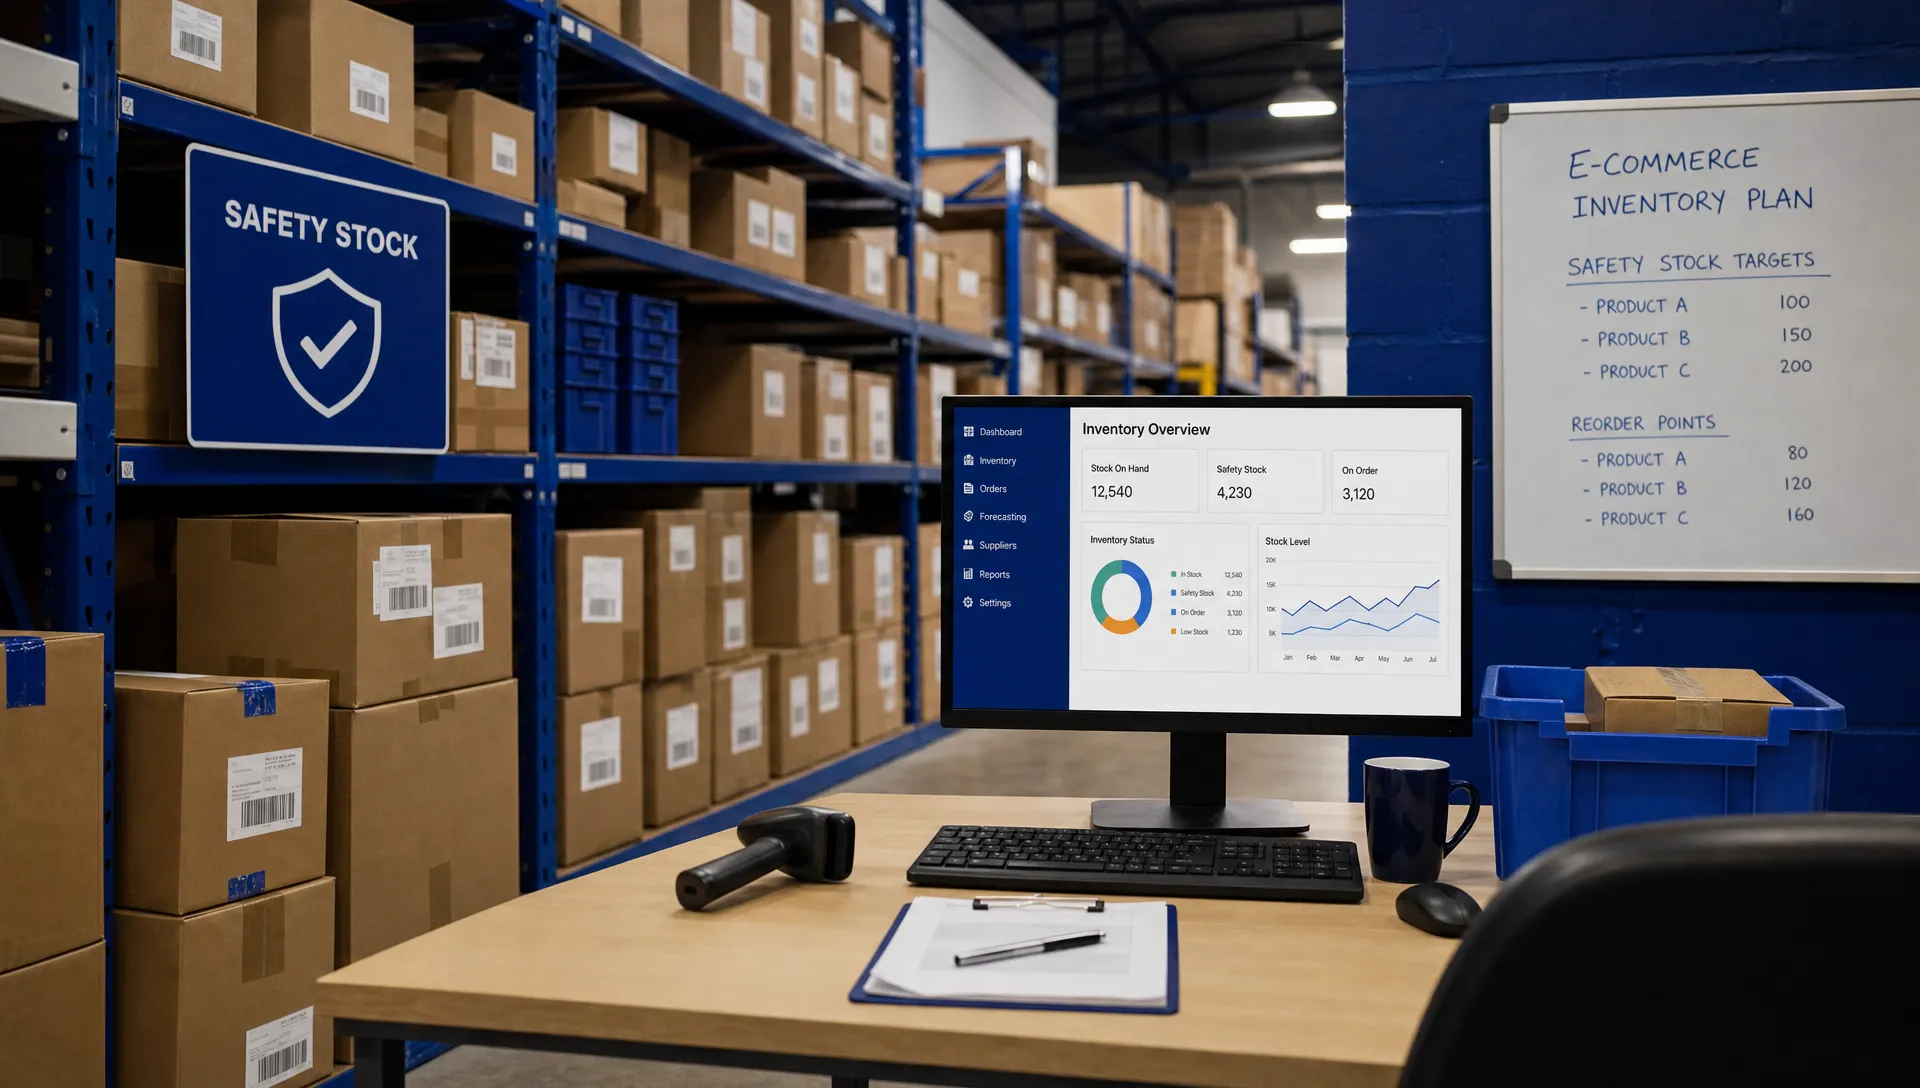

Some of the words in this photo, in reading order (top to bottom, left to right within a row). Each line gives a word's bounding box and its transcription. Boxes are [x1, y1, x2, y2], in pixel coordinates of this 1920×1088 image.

[1569, 146, 1760, 180] E-COMMERCE
[1572, 189, 1726, 219] INVENTORY
[1747, 186, 1813, 211] PLAN
[225, 200, 328, 243] SAFETY
[336, 221, 418, 260] STOCK
[1568, 255, 1644, 276] SAFETY
[1660, 254, 1723, 272] STOCK
[1732, 251, 1815, 270] TARGETS
[1596, 298, 1668, 315] PRODUCT
[1675, 296, 1688, 313] A
[1780, 294, 1810, 310] 100
[1598, 330, 1669, 348] PRODUCT
[1679, 329, 1691, 346] B
[1783, 326, 1812, 343] 150
[1600, 363, 1669, 380] PRODUCT
[1678, 362, 1691, 378] C
[1780, 358, 1813, 374] 200
[1571, 415, 1645, 433] REORDER
[1658, 414, 1716, 431] POINTS
[979, 427, 1023, 437] Dashboard
[1082, 422, 1145, 439] Inventory
[1148, 422, 1211, 436] Overview
[979, 456, 1017, 468] Inventory
[1597, 452, 1665, 468] PRODUCT
[1675, 451, 1687, 467] A
[1787, 445, 1808, 461] 80
[1090, 463, 1114, 473] Stock
[1114, 463, 1127, 473] On
[1128, 464, 1150, 473] Hand
[1216, 464, 1243, 476] Safety
[1243, 465, 1267, 474] Stock
[1341, 465, 1354, 475] On
[1355, 466, 1379, 475] Order
[979, 484, 1008, 494] Orders
[1091, 485, 1133, 500] 12,540
[1599, 481, 1665, 497] PRODUCT
[1676, 480, 1688, 496] B
[1785, 476, 1812, 491] 120
[1216, 486, 1253, 501] 4,230
[1342, 487, 1375, 503] 3,120
[979, 512, 1027, 524] Forecasting
[1601, 511, 1667, 527] PRODUCT
[1677, 510, 1689, 526] C
[1787, 507, 1815, 522] 160
[979, 540, 1018, 552] Suppliers
[1090, 535, 1128, 547] Inventory
[1129, 535, 1155, 545] Status
[1265, 536, 1289, 546] Stock
[1289, 537, 1311, 546] Level
[1265, 556, 1277, 564] 20K
[979, 569, 1011, 581] Reports
[1180, 570, 1187, 578] In
[1186, 570, 1203, 578] Stock
[1224, 571, 1243, 580] 12,540
[1180, 589, 1199, 598] Safety
[1199, 589, 1215, 597] Stock
[1226, 589, 1243, 598] 4,230
[979, 598, 1012, 610] Settings
[1266, 605, 1277, 613] 10K
[1180, 608, 1190, 616] On
[1189, 608, 1206, 617] Order
[1226, 609, 1243, 618] 3,120
[1180, 628, 1193, 636] Low
[1192, 628, 1209, 636] Stock
[1227, 628, 1243, 637] 1,230
[1268, 629, 1277, 637] 5K
[1283, 653, 1294, 661] Jan
[1329, 654, 1341, 662] Mar
[1354, 655, 1365, 663] Apr
[1377, 655, 1390, 664] May
[1402, 655, 1414, 663] Jun
